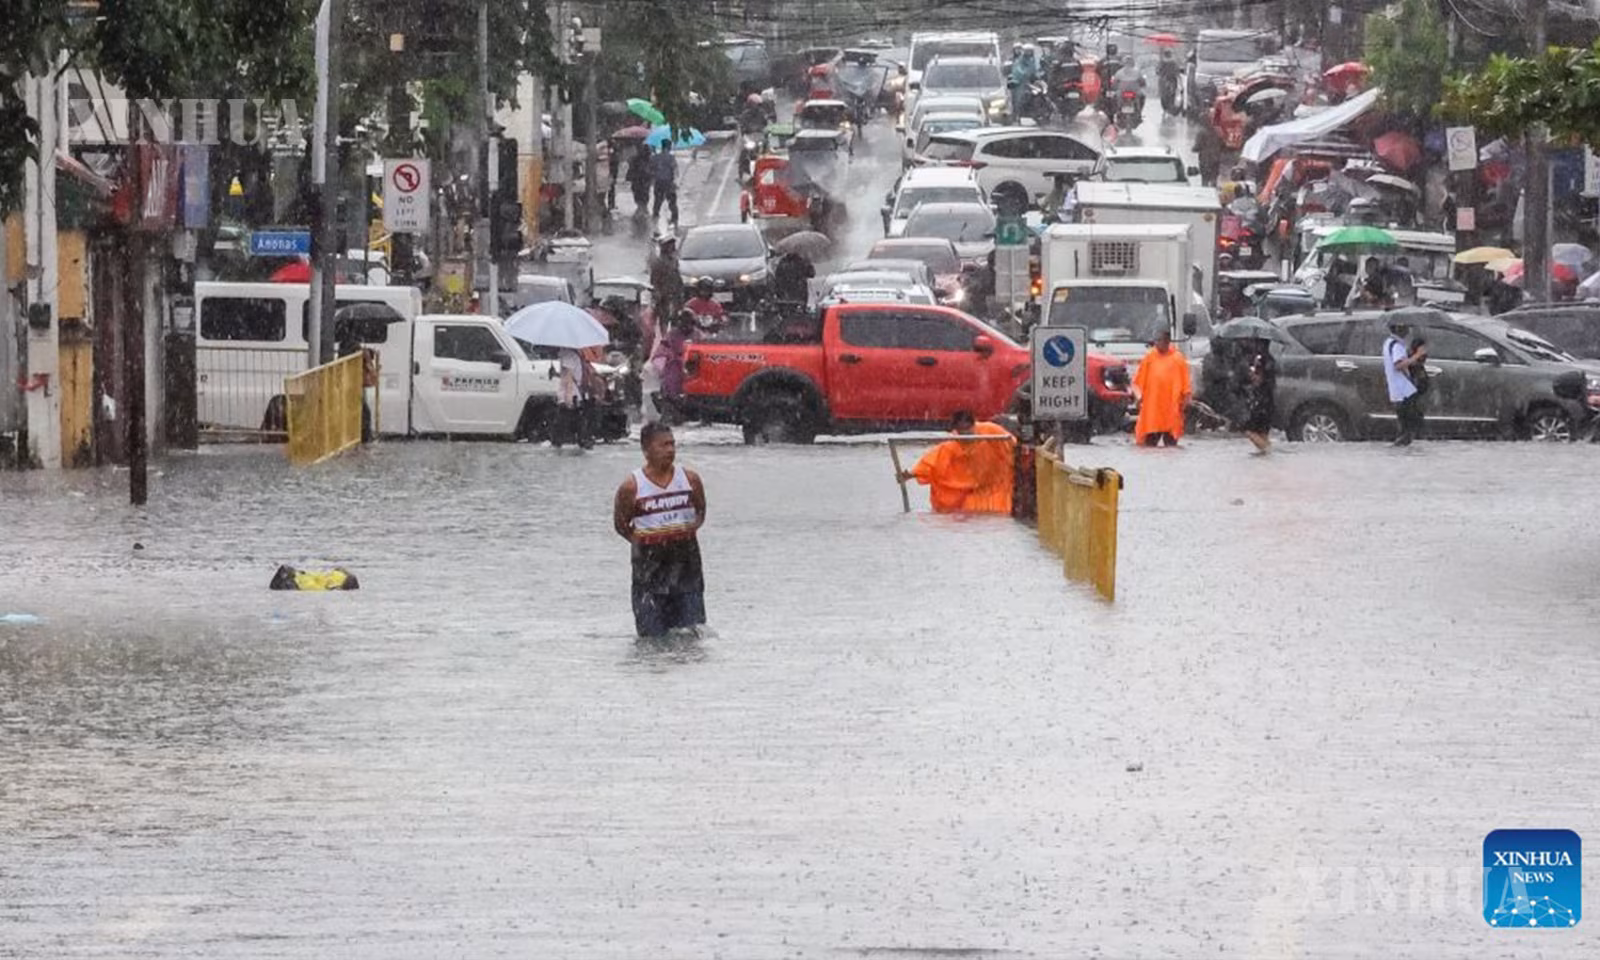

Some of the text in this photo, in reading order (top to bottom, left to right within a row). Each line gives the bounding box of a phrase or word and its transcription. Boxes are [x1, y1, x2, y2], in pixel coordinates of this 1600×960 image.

[398, 195, 414, 204] NO
[1042, 375, 1076, 389] KEEP
[1039, 394, 1080, 408] RIGHT
